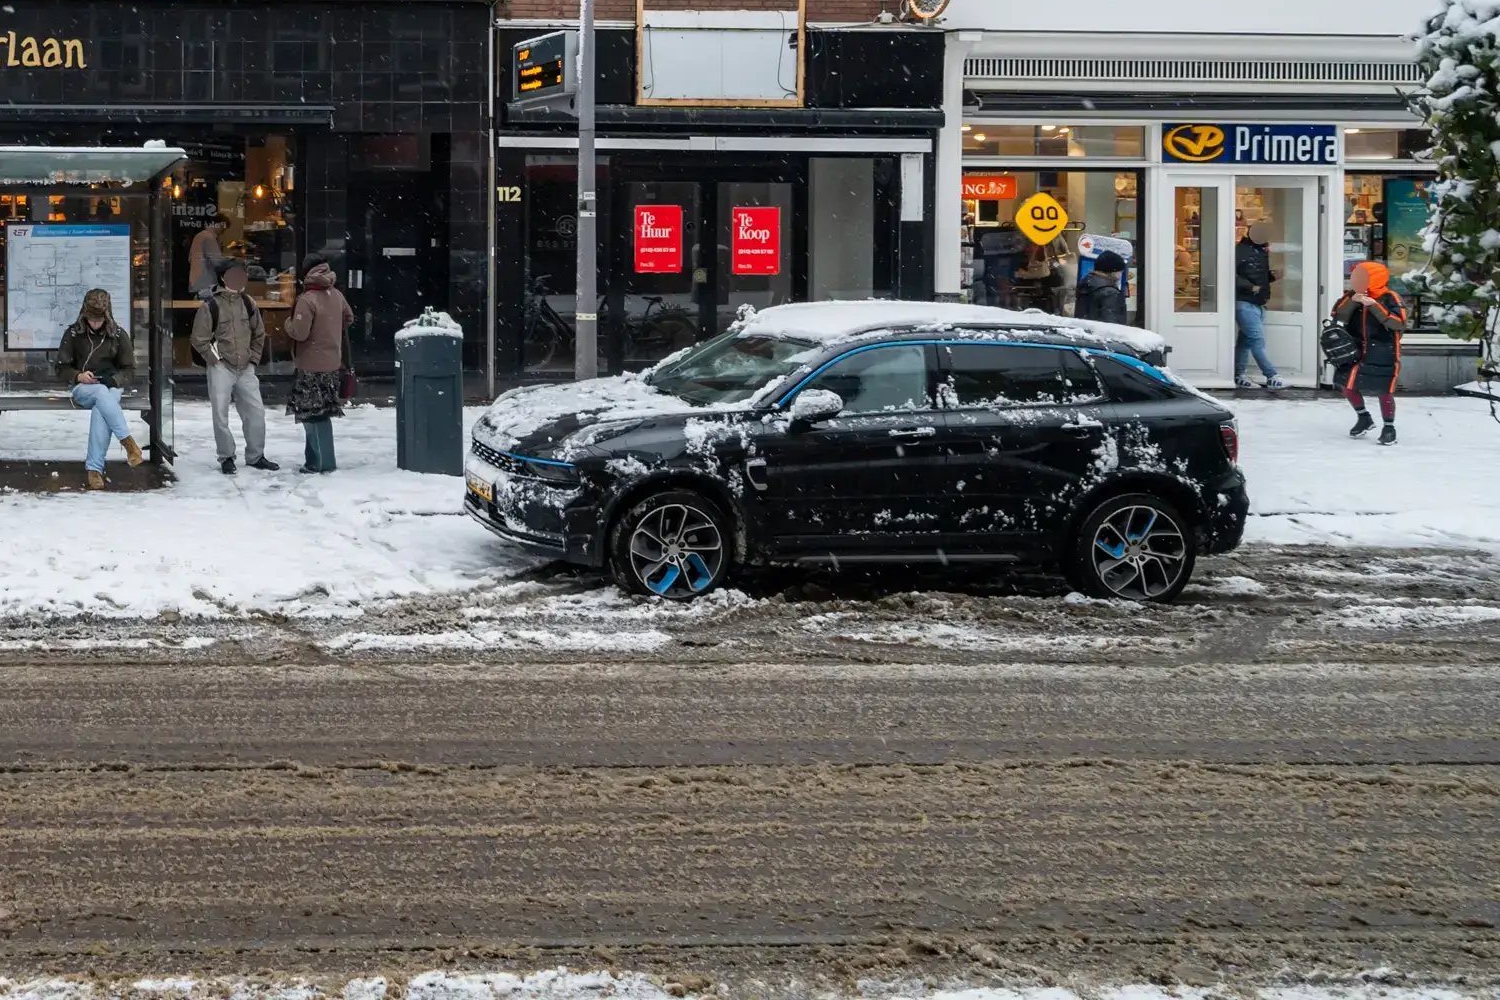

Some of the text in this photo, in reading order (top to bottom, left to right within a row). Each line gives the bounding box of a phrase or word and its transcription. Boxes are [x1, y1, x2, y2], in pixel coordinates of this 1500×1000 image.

[1235, 126, 1338, 162] Primera
[497, 186, 521, 202] 112
[640, 211, 656, 225] Te
[738, 213, 753, 227] Te
[641, 225, 672, 238] Huur
[739, 226, 770, 244] Koop
